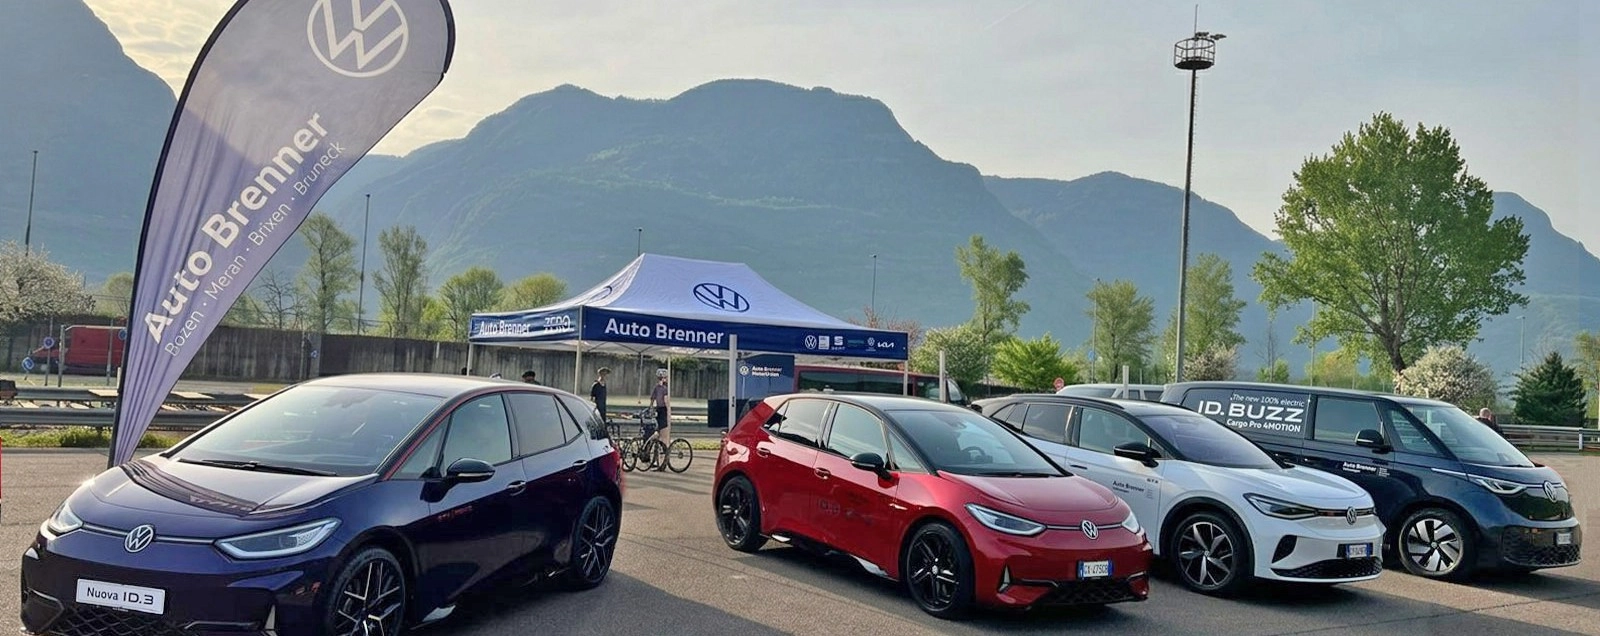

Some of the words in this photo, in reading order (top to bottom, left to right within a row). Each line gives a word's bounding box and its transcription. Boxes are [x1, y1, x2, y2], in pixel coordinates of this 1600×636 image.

[144, 250, 213, 344] Auto
[201, 112, 328, 249] Brenner
[164, 309, 204, 357] Bozen
[204, 254, 246, 300] Meran
[248, 202, 292, 246] Brixen
[293, 140, 346, 195] Bruneck
[479, 320, 498, 335] Auto
[499, 320, 531, 335] Brenner
[604, 318, 651, 338] Auto
[655, 323, 724, 344] Brenner
[1233, 393, 1244, 402] The
[1261, 396, 1280, 405] 100%
[1280, 398, 1305, 408] electric
[1226, 418, 1248, 428] Cargo
[1249, 420, 1262, 429] Pro
[1263, 421, 1301, 433] 4MOTION
[86, 586, 118, 601] Nuova
[123, 591, 154, 605] ID.3
